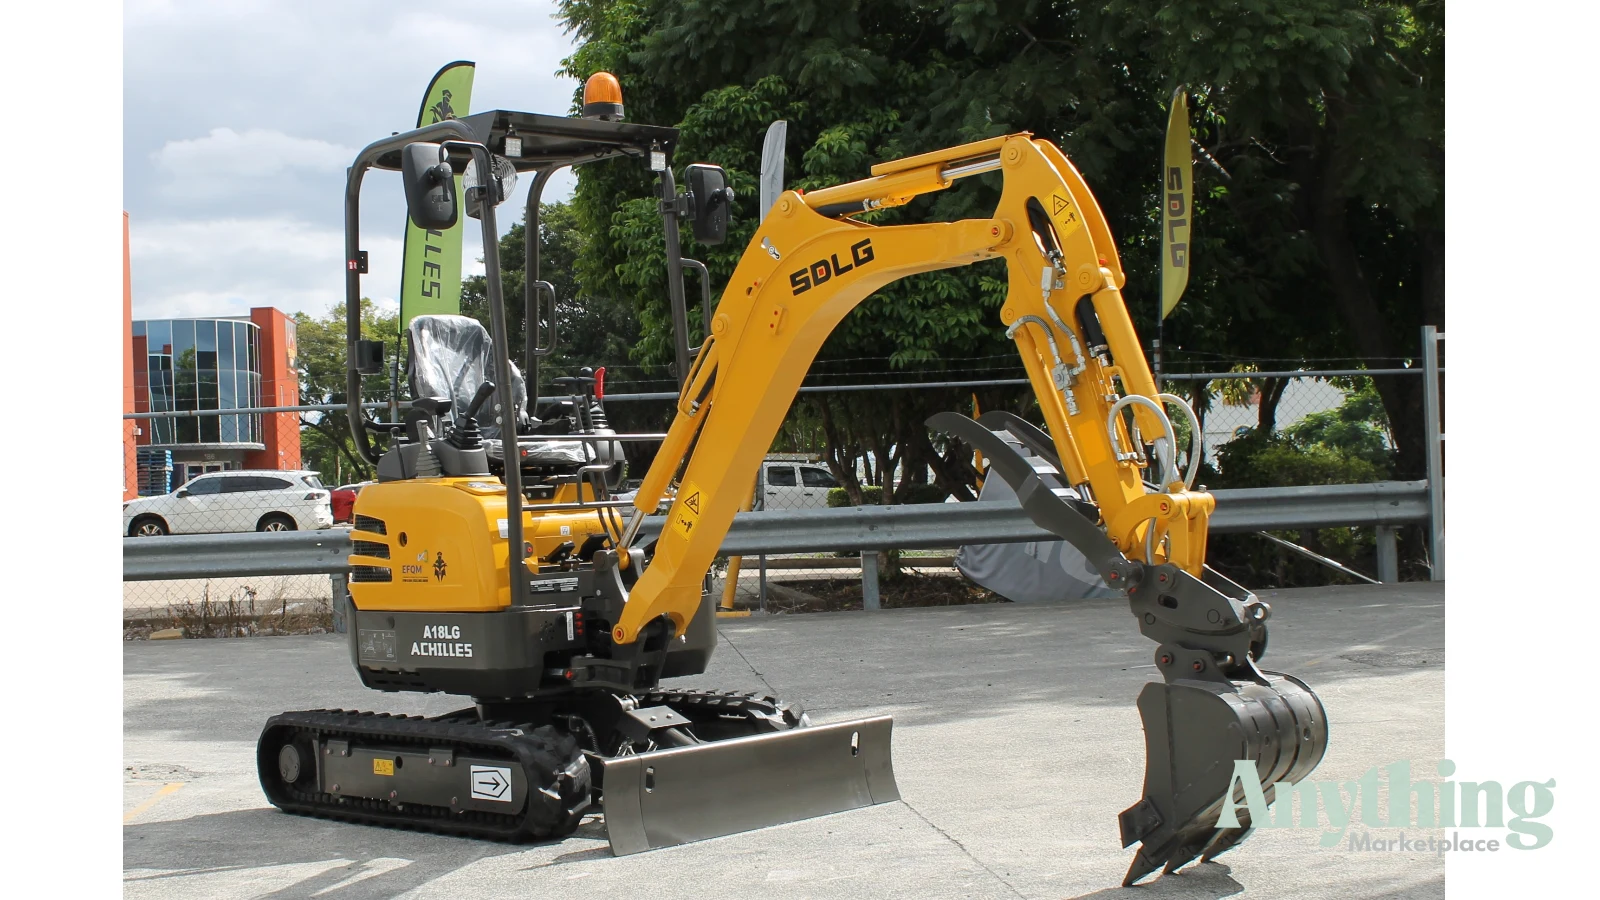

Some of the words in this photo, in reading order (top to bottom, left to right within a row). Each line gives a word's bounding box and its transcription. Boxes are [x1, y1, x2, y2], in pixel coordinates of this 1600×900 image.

[1167, 167, 1187, 268] SDLG
[421, 229, 443, 299] LLES
[789, 238, 875, 296] SDLG
[402, 565, 422, 574] EFQM
[410, 642, 473, 658] ACHILLES
[423, 625, 461, 639] A18LG
